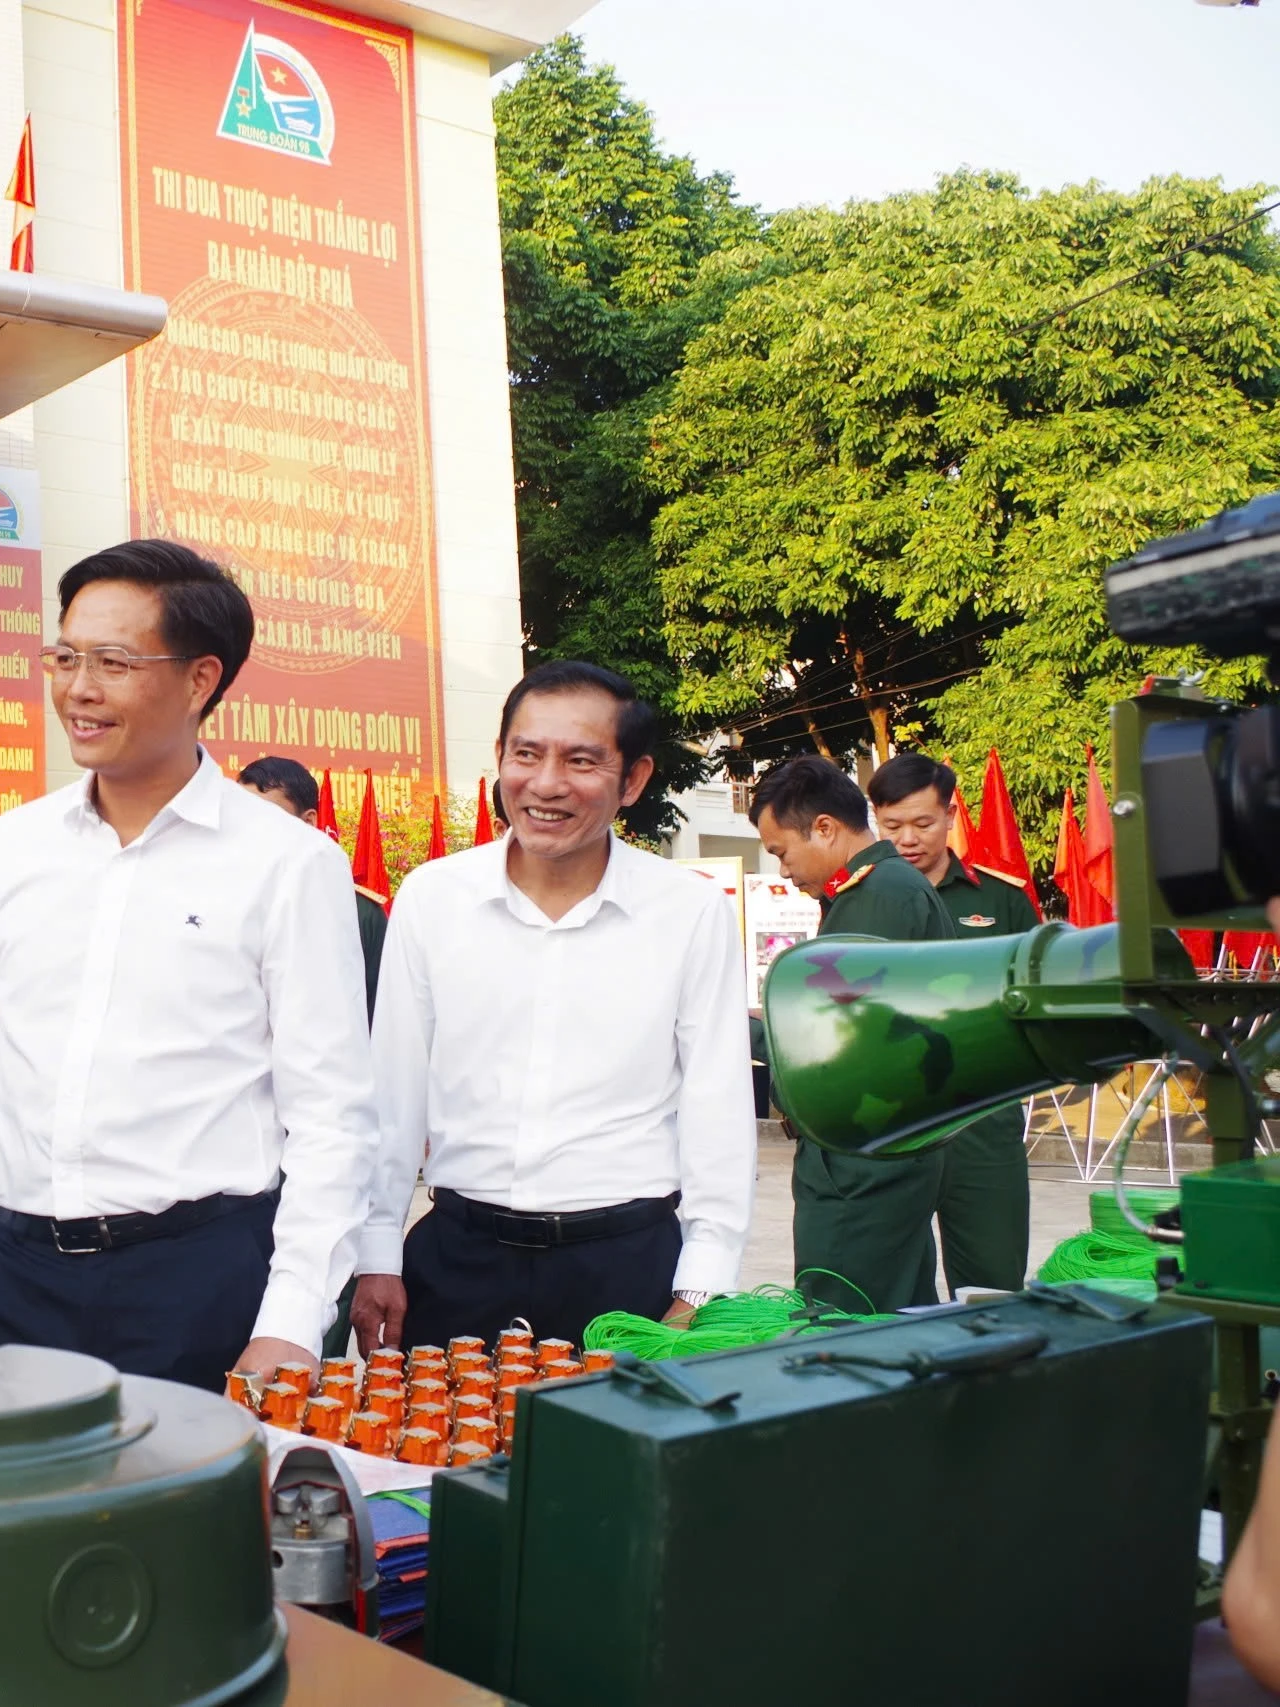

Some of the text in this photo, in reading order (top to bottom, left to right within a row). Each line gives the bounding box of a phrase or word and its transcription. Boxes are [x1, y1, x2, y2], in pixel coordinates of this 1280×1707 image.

[237, 123, 268, 143] TRUNG
[269, 130, 298, 152] ĐOÀN
[152, 166, 397, 269] THI ĐUA THỰC HIỆN THẮNG LỢI
[207, 240, 354, 309] BA KHÂU ĐỘT PHÁ
[225, 519, 256, 548] CAO
[359, 538, 408, 569] TRÁCH
[0, 564, 24, 589] HUY
[260, 568, 292, 600] NÊU
[354, 578, 386, 612] CỦA
[0, 604, 41, 635] THỐNG
[256, 617, 288, 647] CÁN
[322, 623, 364, 657] ĐẢNG
[368, 630, 402, 661] VIÊN
[0, 648, 30, 680] HIẾN
[230, 694, 271, 744] TÂM
[275, 697, 310, 747] XÂY
[314, 706, 363, 757] DỰNG
[366, 711, 402, 754] ĐƠN
[404, 717, 422, 764] VỊ
